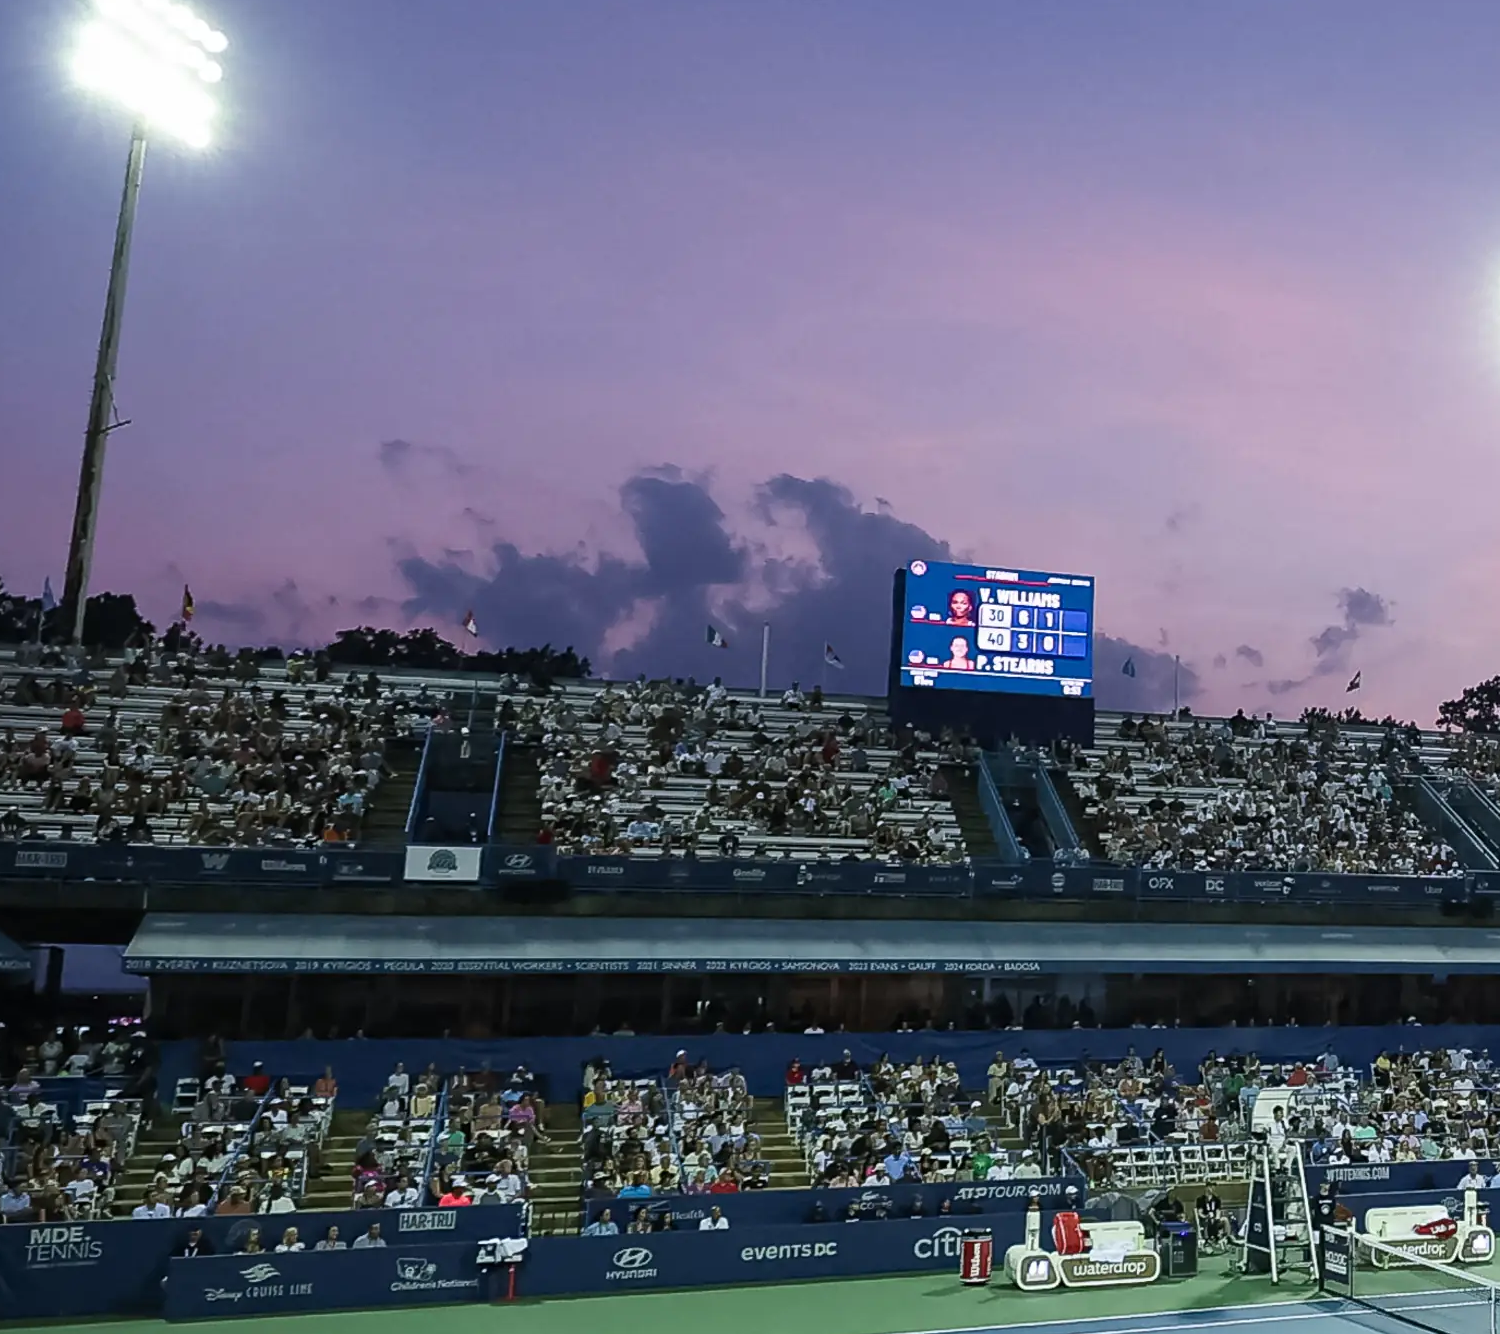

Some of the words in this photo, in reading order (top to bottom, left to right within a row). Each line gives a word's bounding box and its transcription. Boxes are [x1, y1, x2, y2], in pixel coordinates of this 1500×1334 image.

[980, 588, 995, 603] V.
[997, 589, 1060, 608] WILLIAMS
[989, 609, 1004, 622] 30
[1045, 612, 1053, 627] 1
[987, 633, 1004, 646] 40
[976, 655, 991, 671] P.
[992, 656, 1054, 675] STEARNS
[1148, 877, 1174, 890] OFX
[1205, 879, 1225, 891] DC
[401, 1212, 454, 1229] HAR-TRU
[671, 1208, 705, 1221] Health
[24, 1240, 104, 1263] TENNIS
[914, 1229, 962, 1259] citi
[605, 1267, 658, 1281] HYUNDAI
[1073, 1260, 1147, 1276] waterdrop
[204, 1287, 243, 1303] Disney
[245, 1283, 284, 1299] CRUISE
[289, 1282, 313, 1296] LINE
